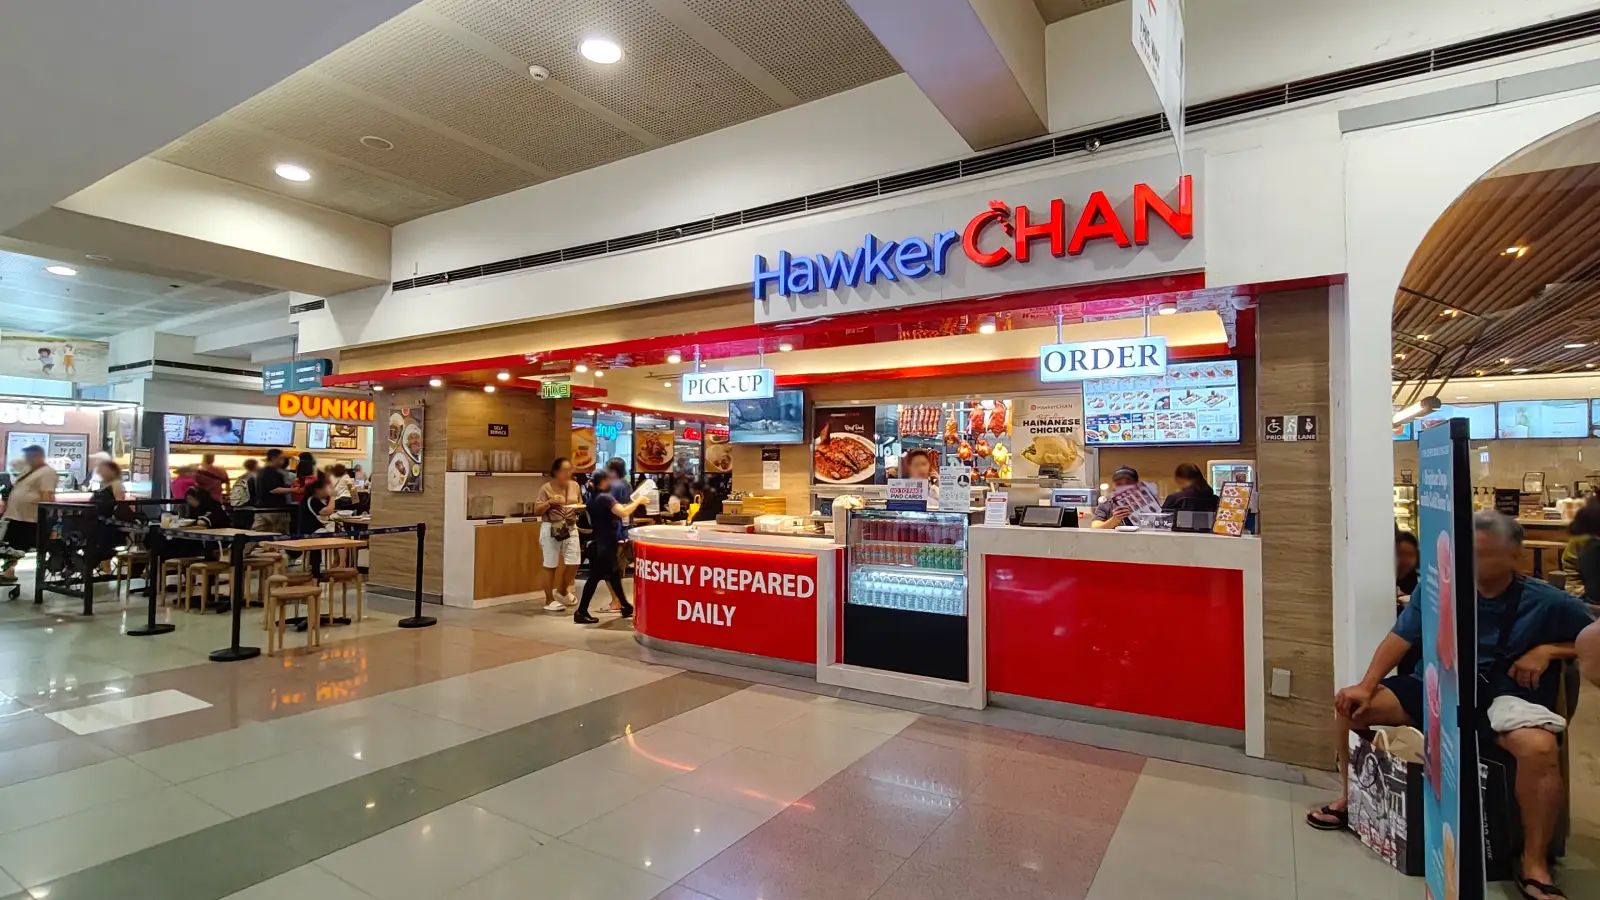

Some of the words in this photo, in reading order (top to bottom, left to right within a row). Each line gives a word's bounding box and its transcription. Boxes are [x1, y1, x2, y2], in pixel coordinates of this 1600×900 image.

[1043, 344, 1161, 373] ORDER
[687, 374, 763, 396] PICK-UP
[1022, 418, 1081, 427] HAINANESE
[635, 557, 696, 586] FRESHLY
[700, 565, 815, 599] PREPARED
[677, 599, 737, 627] DAILY
